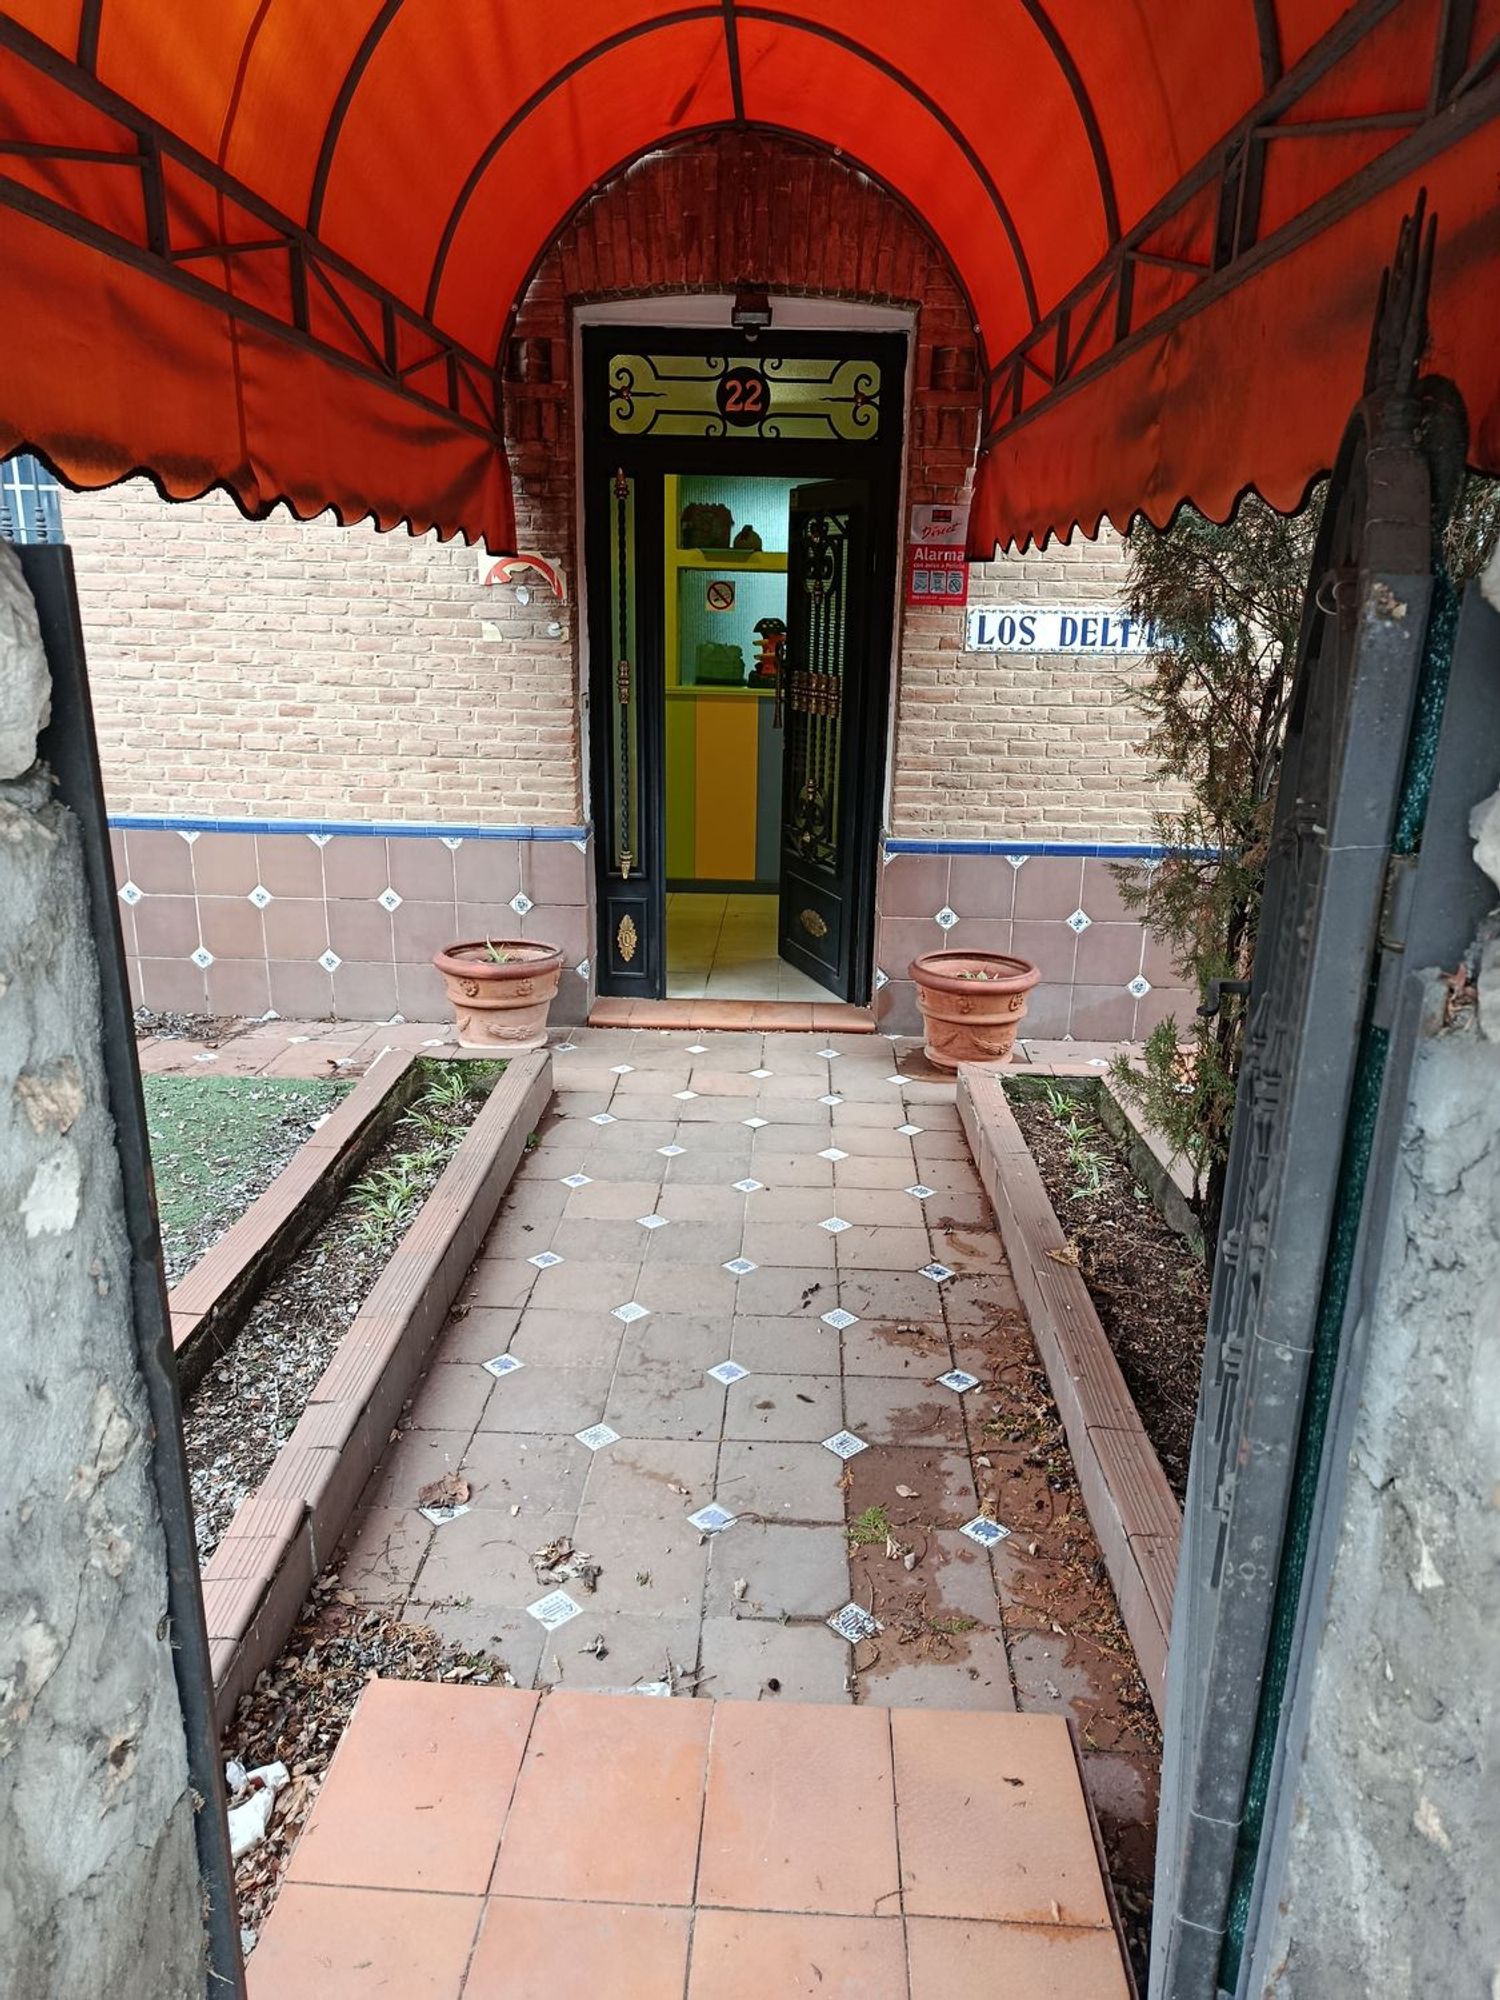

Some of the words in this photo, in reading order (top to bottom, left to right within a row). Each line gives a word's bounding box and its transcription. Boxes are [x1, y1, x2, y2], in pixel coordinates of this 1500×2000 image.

[725, 379, 763, 412] 22
[914, 547, 965, 561] Alarma
[977, 614, 1036, 646] LOS
